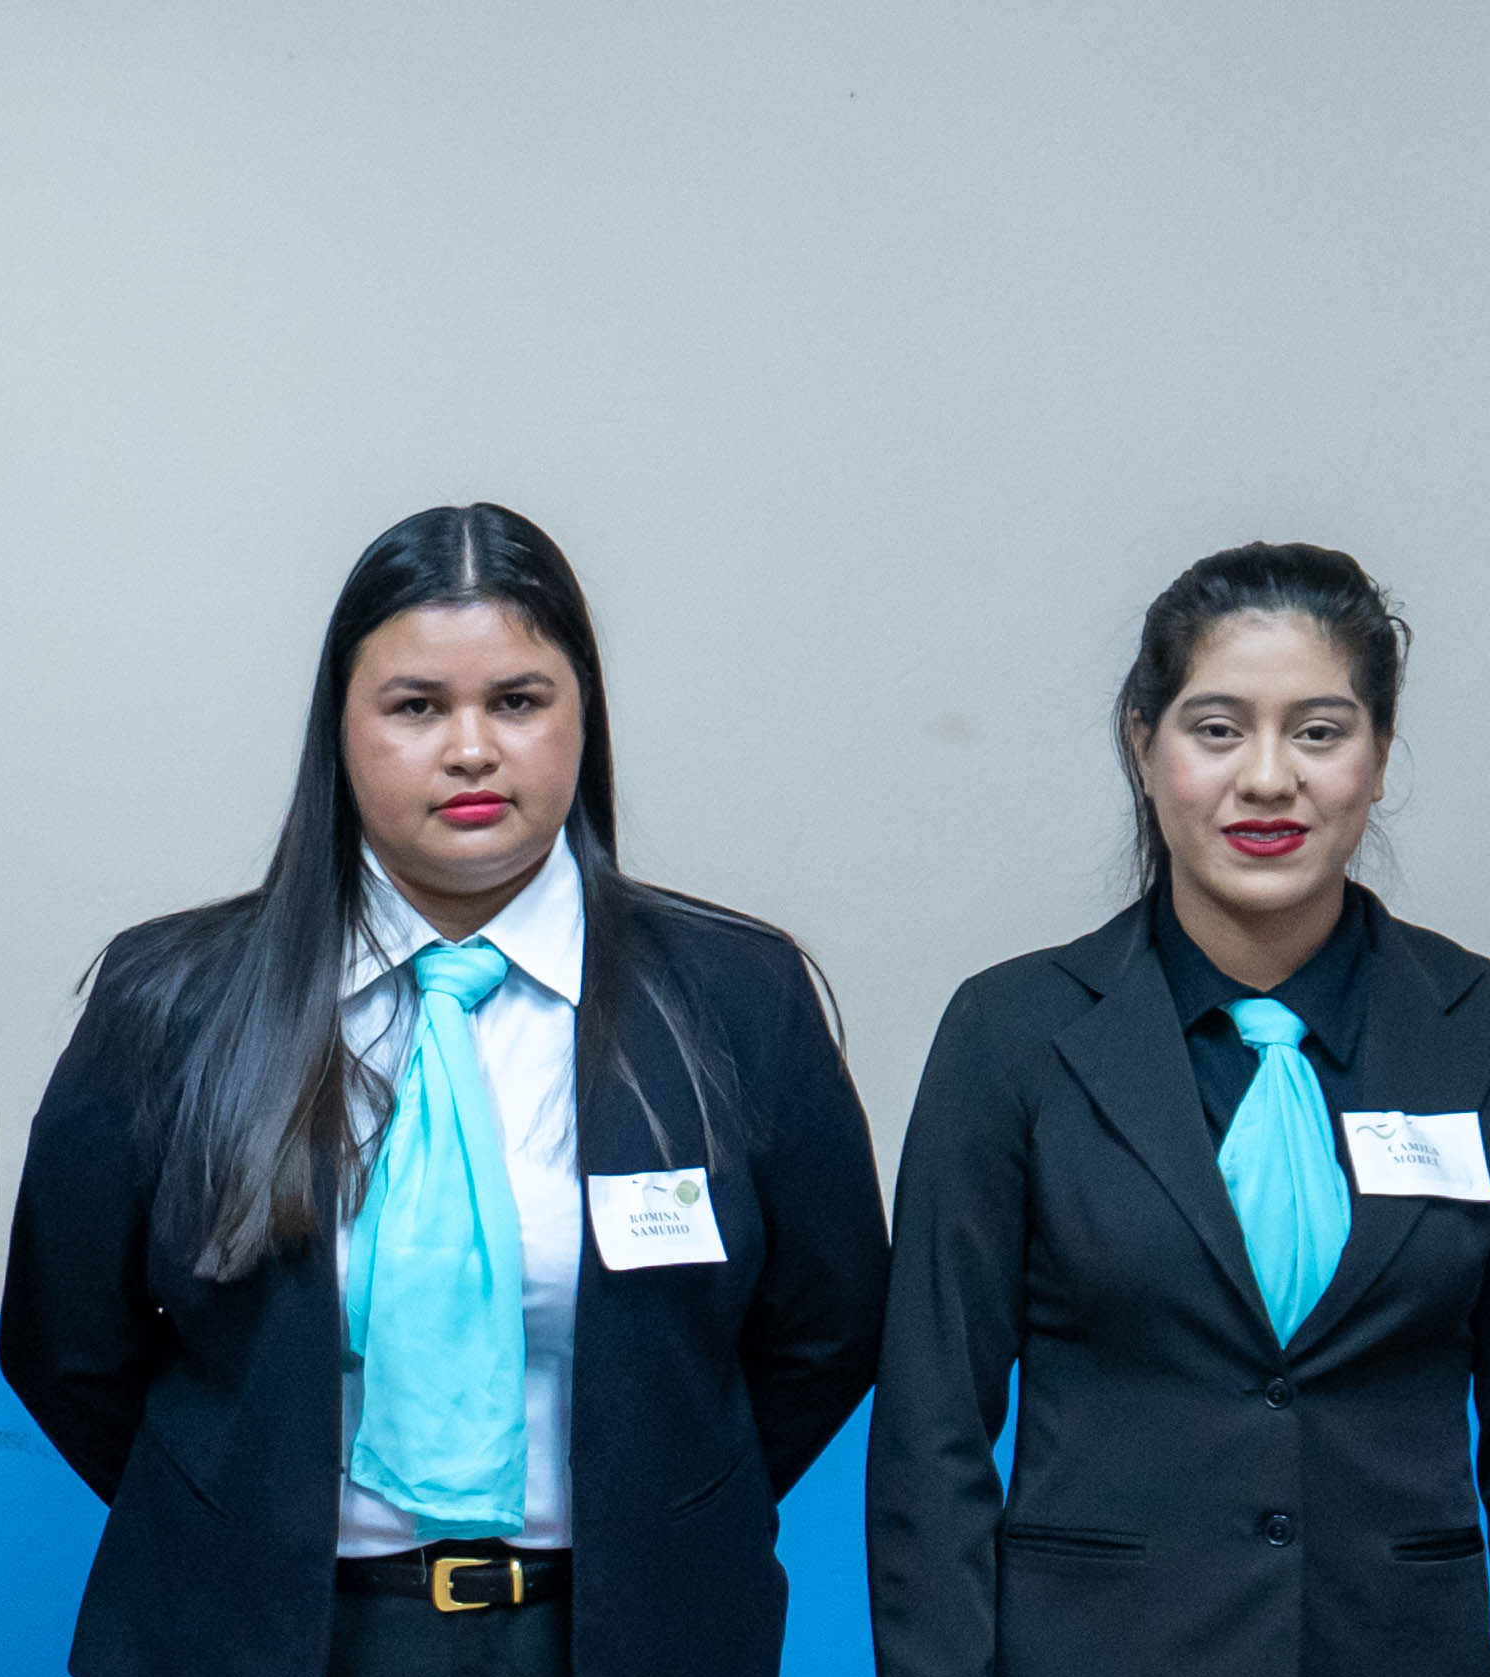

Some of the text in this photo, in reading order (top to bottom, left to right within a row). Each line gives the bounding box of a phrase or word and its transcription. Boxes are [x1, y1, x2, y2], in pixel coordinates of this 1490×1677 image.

[1387, 1142, 1440, 1157] CAMILA
[629, 1211, 680, 1224] ROMINA
[630, 1224, 690, 1237] SAMUDIO
